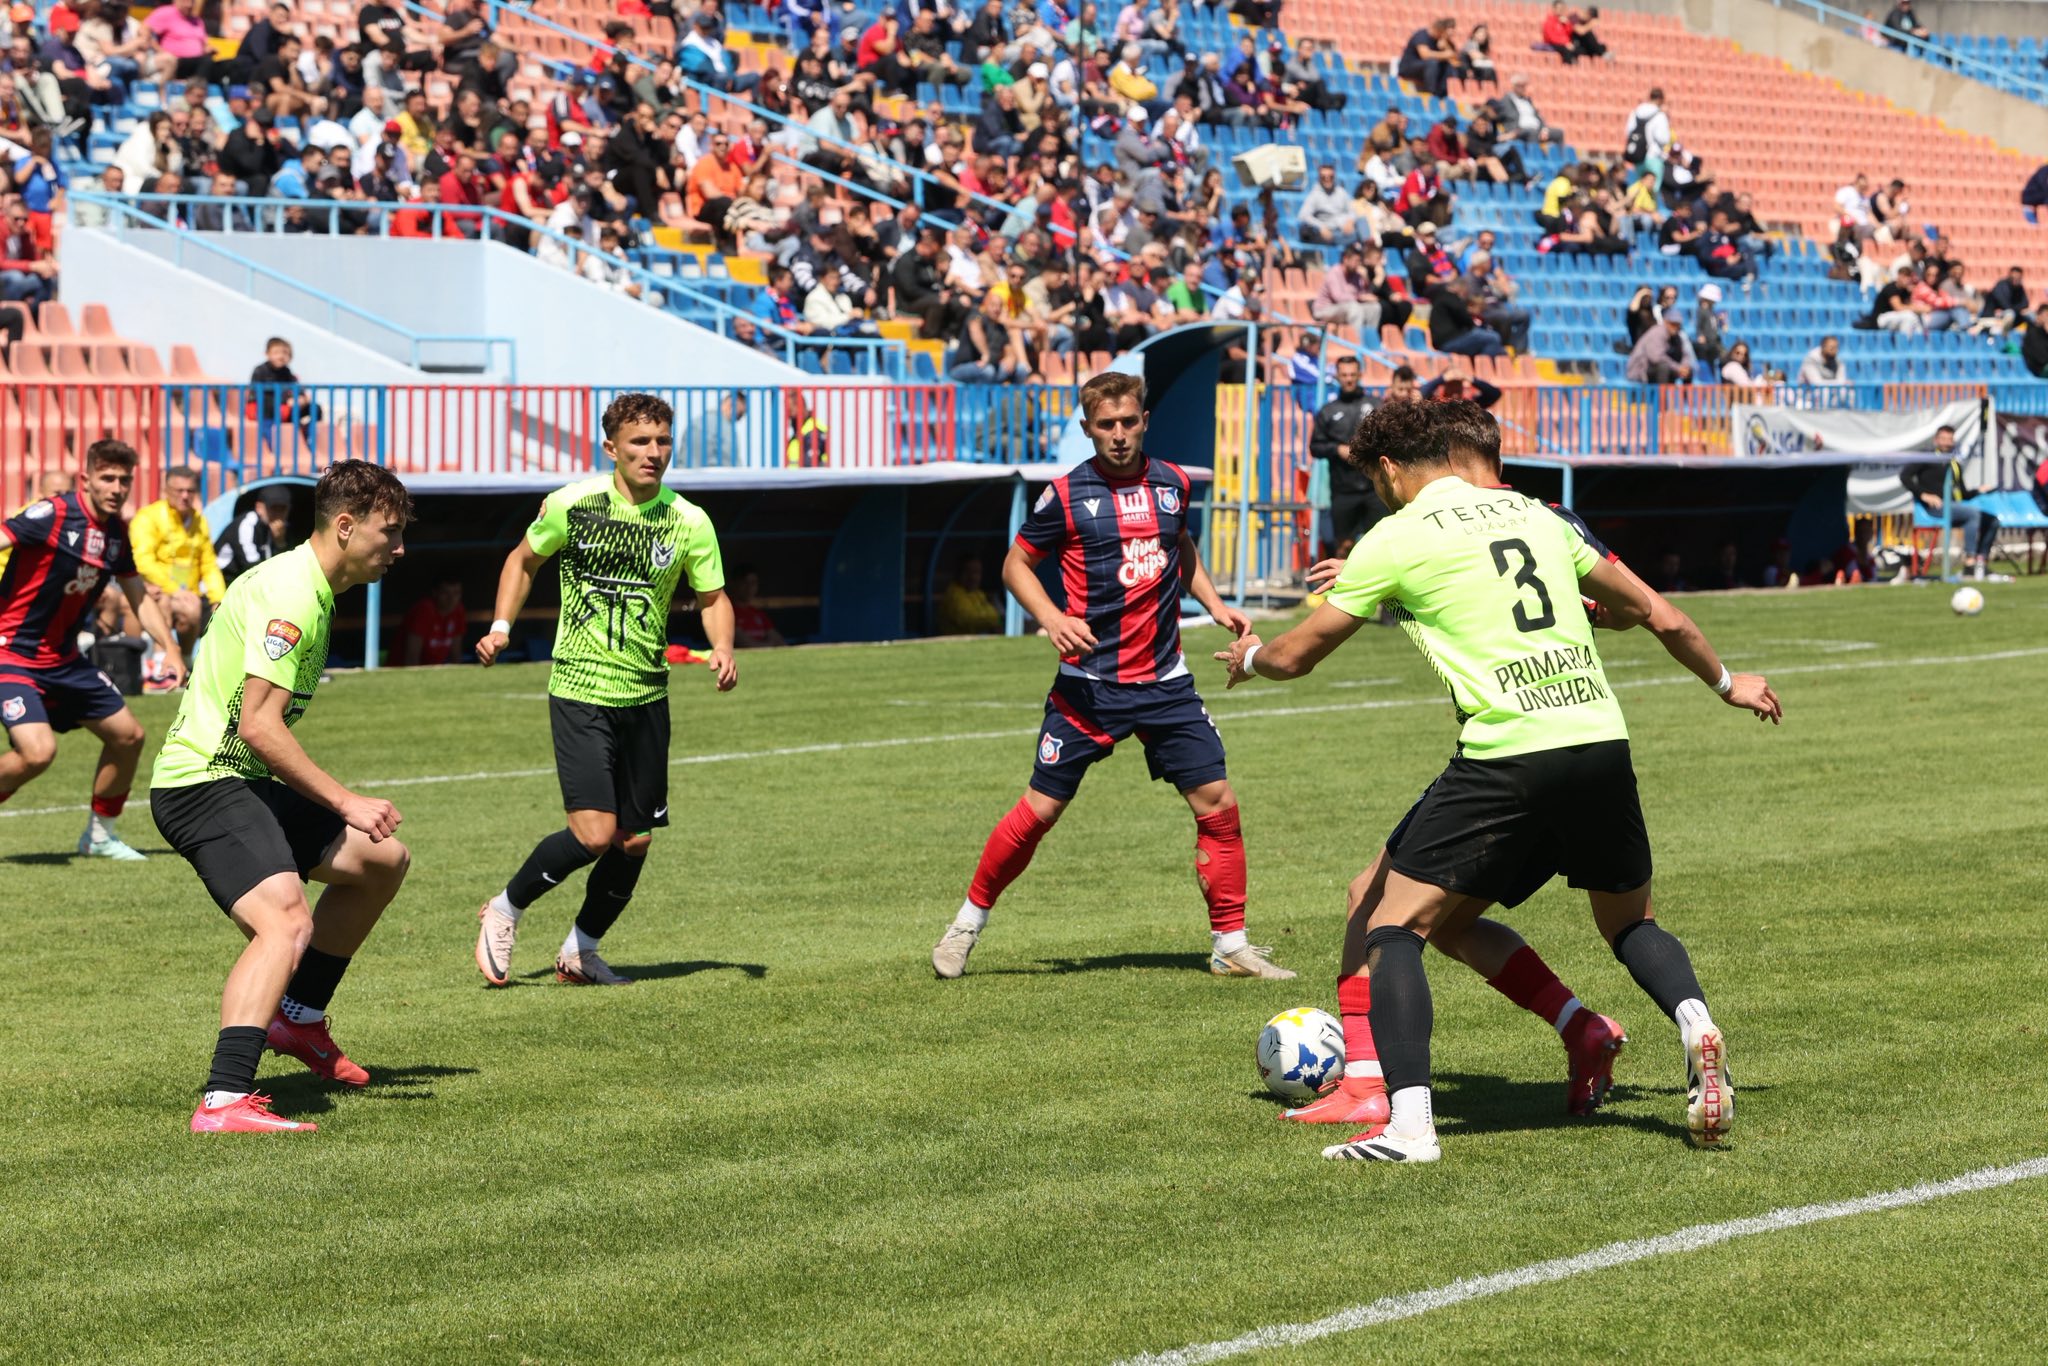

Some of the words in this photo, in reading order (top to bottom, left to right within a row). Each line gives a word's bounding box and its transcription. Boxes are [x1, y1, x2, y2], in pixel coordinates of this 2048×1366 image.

[1122, 537, 1159, 562] Viva
[1118, 549, 1167, 587] Chips
[1489, 538, 1556, 633] 3
[267, 637, 282, 648] LIGA
